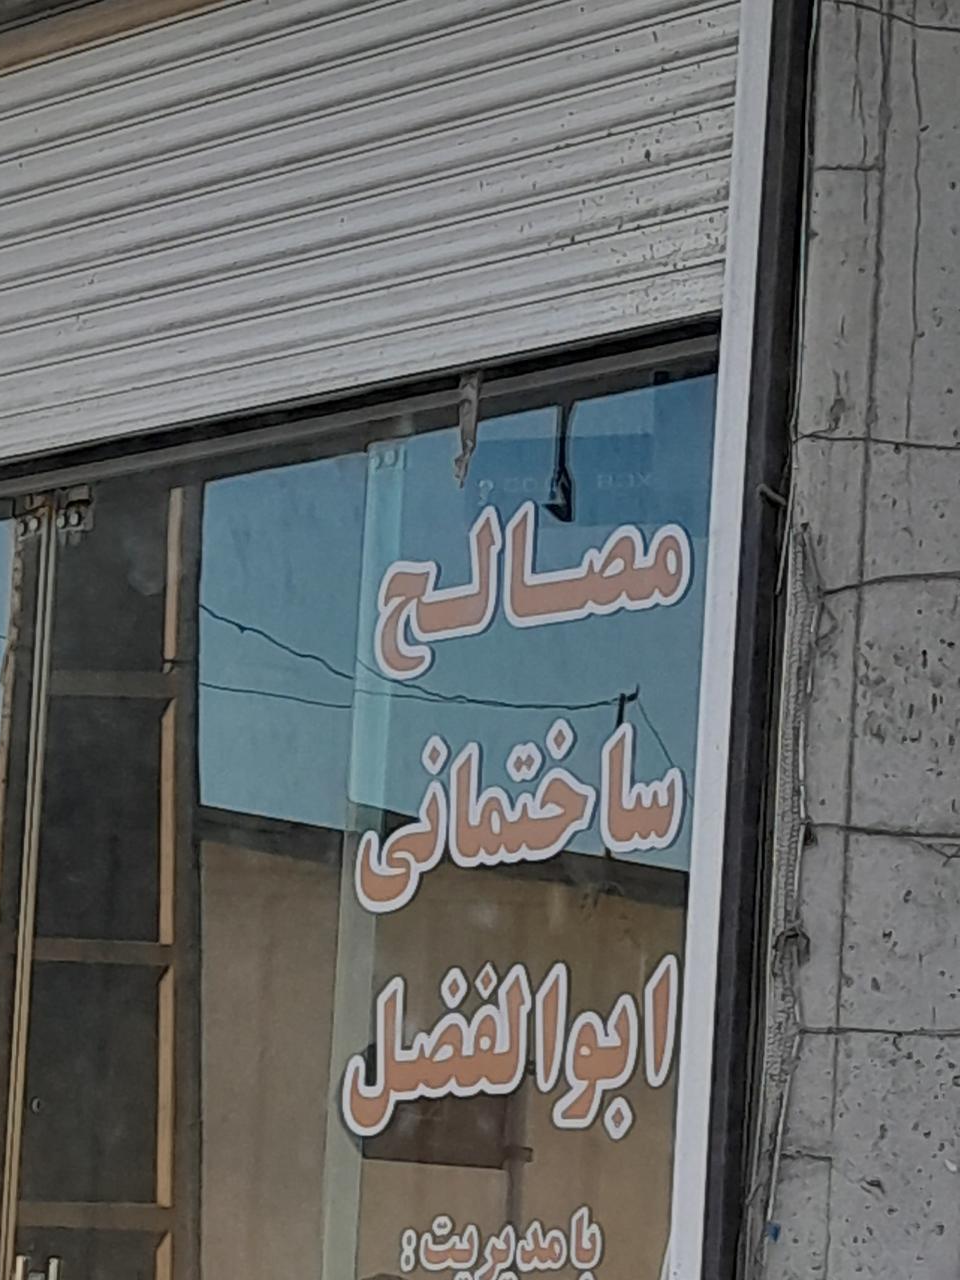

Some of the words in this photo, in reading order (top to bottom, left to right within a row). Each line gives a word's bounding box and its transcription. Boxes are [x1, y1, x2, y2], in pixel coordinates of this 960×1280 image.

[374, 502, 692, 680] مصالح
[354, 719, 684, 914] ساختمانی
[342, 953, 679, 1140] ابوالفضل
